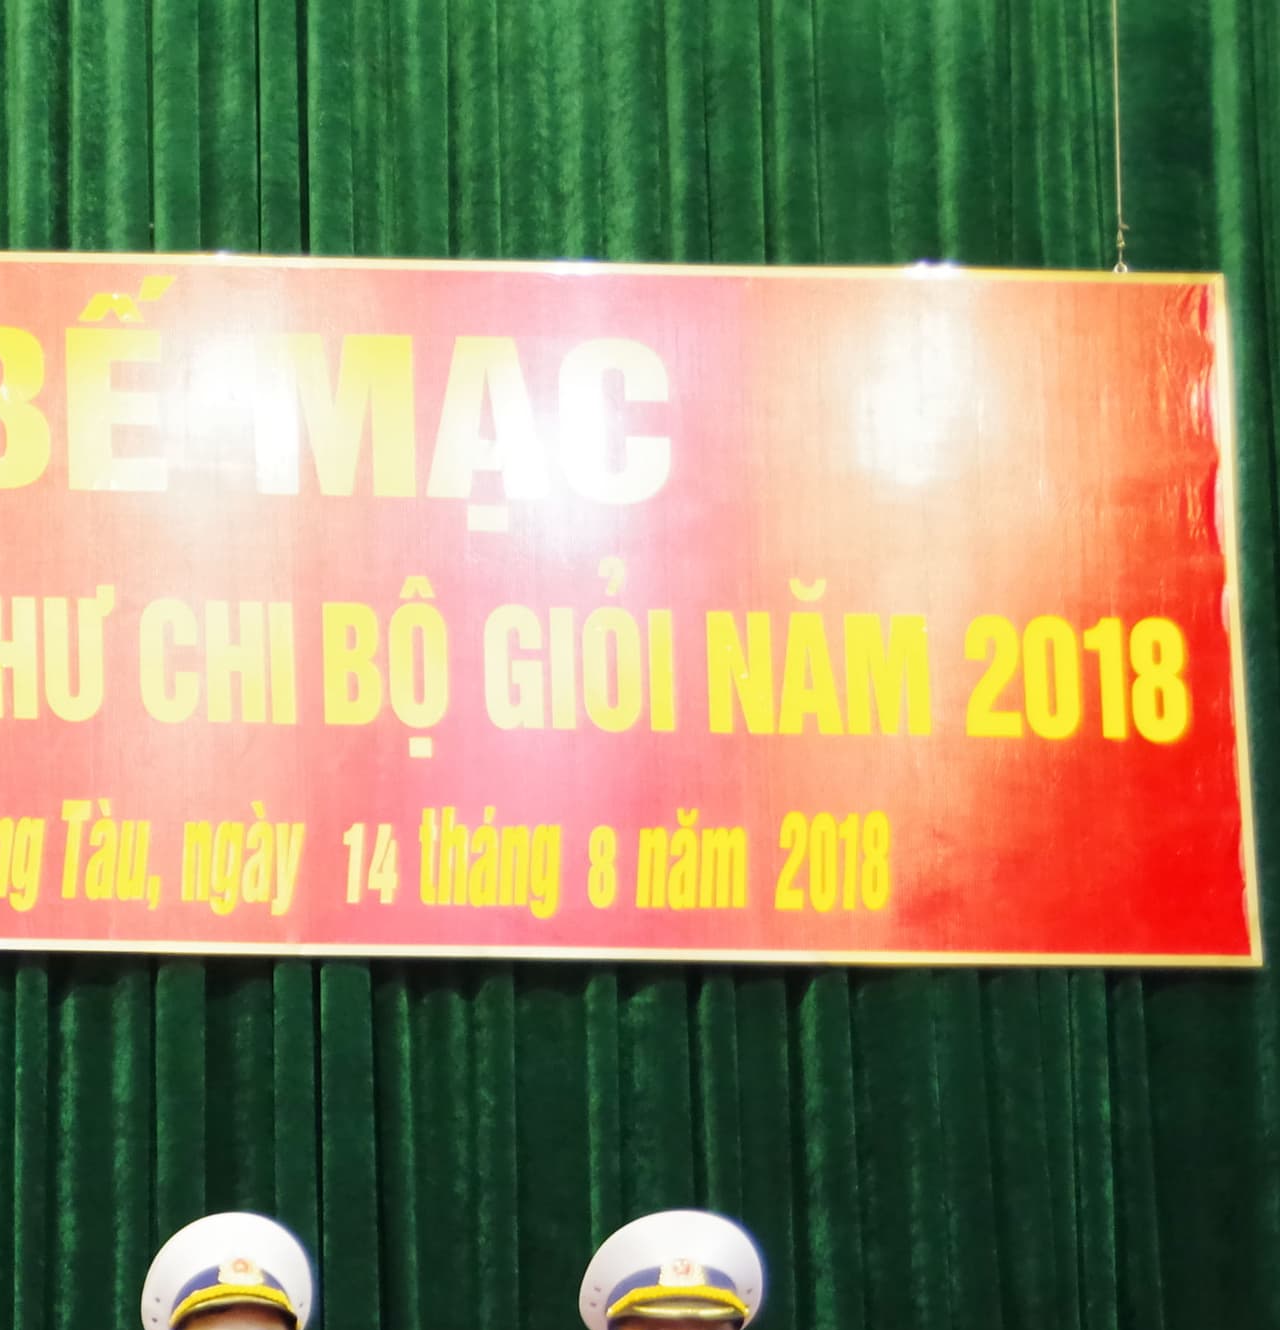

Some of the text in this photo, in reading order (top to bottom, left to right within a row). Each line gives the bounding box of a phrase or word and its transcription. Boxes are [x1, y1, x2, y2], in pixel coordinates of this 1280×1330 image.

[254, 332, 671, 532] MẠC
[138, 598, 298, 725] CHI
[321, 575, 449, 759] BỘ
[483, 556, 676, 733] GIỎI
[706, 578, 932, 737] NĂM
[963, 614, 1190, 744] 2018
[60, 798, 161, 909] Tàu,
[181, 800, 304, 915] ngày
[343, 822, 398, 905] 14
[418, 806, 561, 918] tháng
[587, 825, 617, 908] 8
[635, 807, 747, 910] năm
[775, 810, 890, 912] 2018
